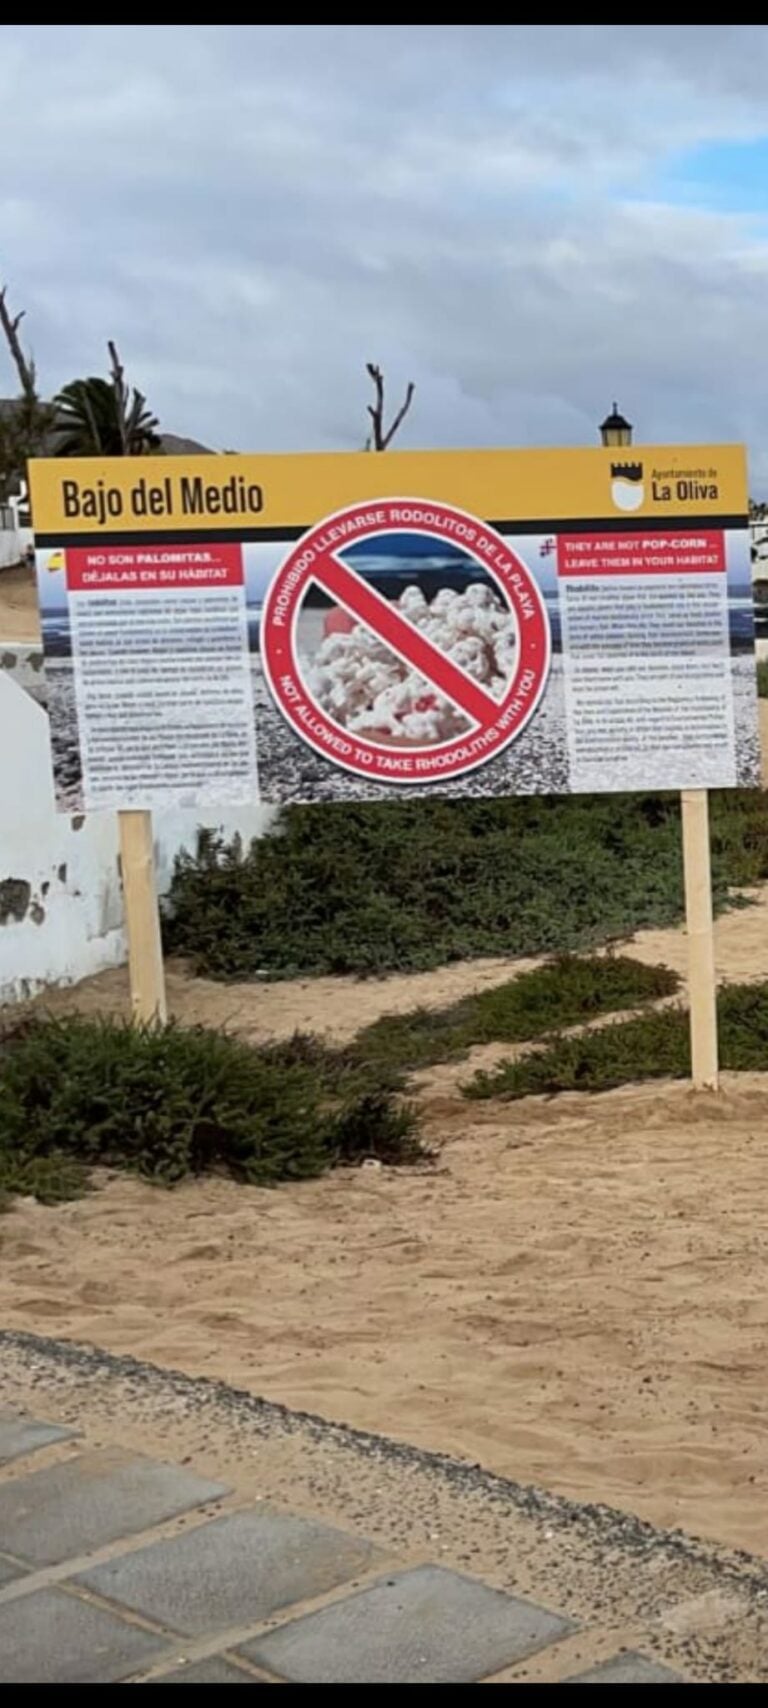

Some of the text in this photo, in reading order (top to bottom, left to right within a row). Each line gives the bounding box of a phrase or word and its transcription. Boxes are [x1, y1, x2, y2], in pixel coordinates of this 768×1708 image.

[651, 468, 718, 480] Ayuntamiento de
[652, 480, 718, 501] La Oliva
[62, 475, 264, 525] Bajo del Medio
[564, 541, 593, 551] THEY
[594, 541, 617, 551] ARE
[618, 540, 640, 550] NOT
[642, 538, 708, 550] POP-CORN
[87, 555, 105, 566] NO
[108, 554, 134, 565] SON
[272, 508, 537, 627] PROHIBIDO LLEVARSE RODOLITOS DE LA PLAYA
[564, 554, 719, 569] LEAVE THEM IN YOUR HABITAT
[82, 570, 138, 583] DÉJALAS
[140, 570, 158, 581] EN
[159, 569, 176, 580] SU
[279, 669, 537, 772] NOT ALLOWED TO TAKE RHODOLITHS WITH YOU
